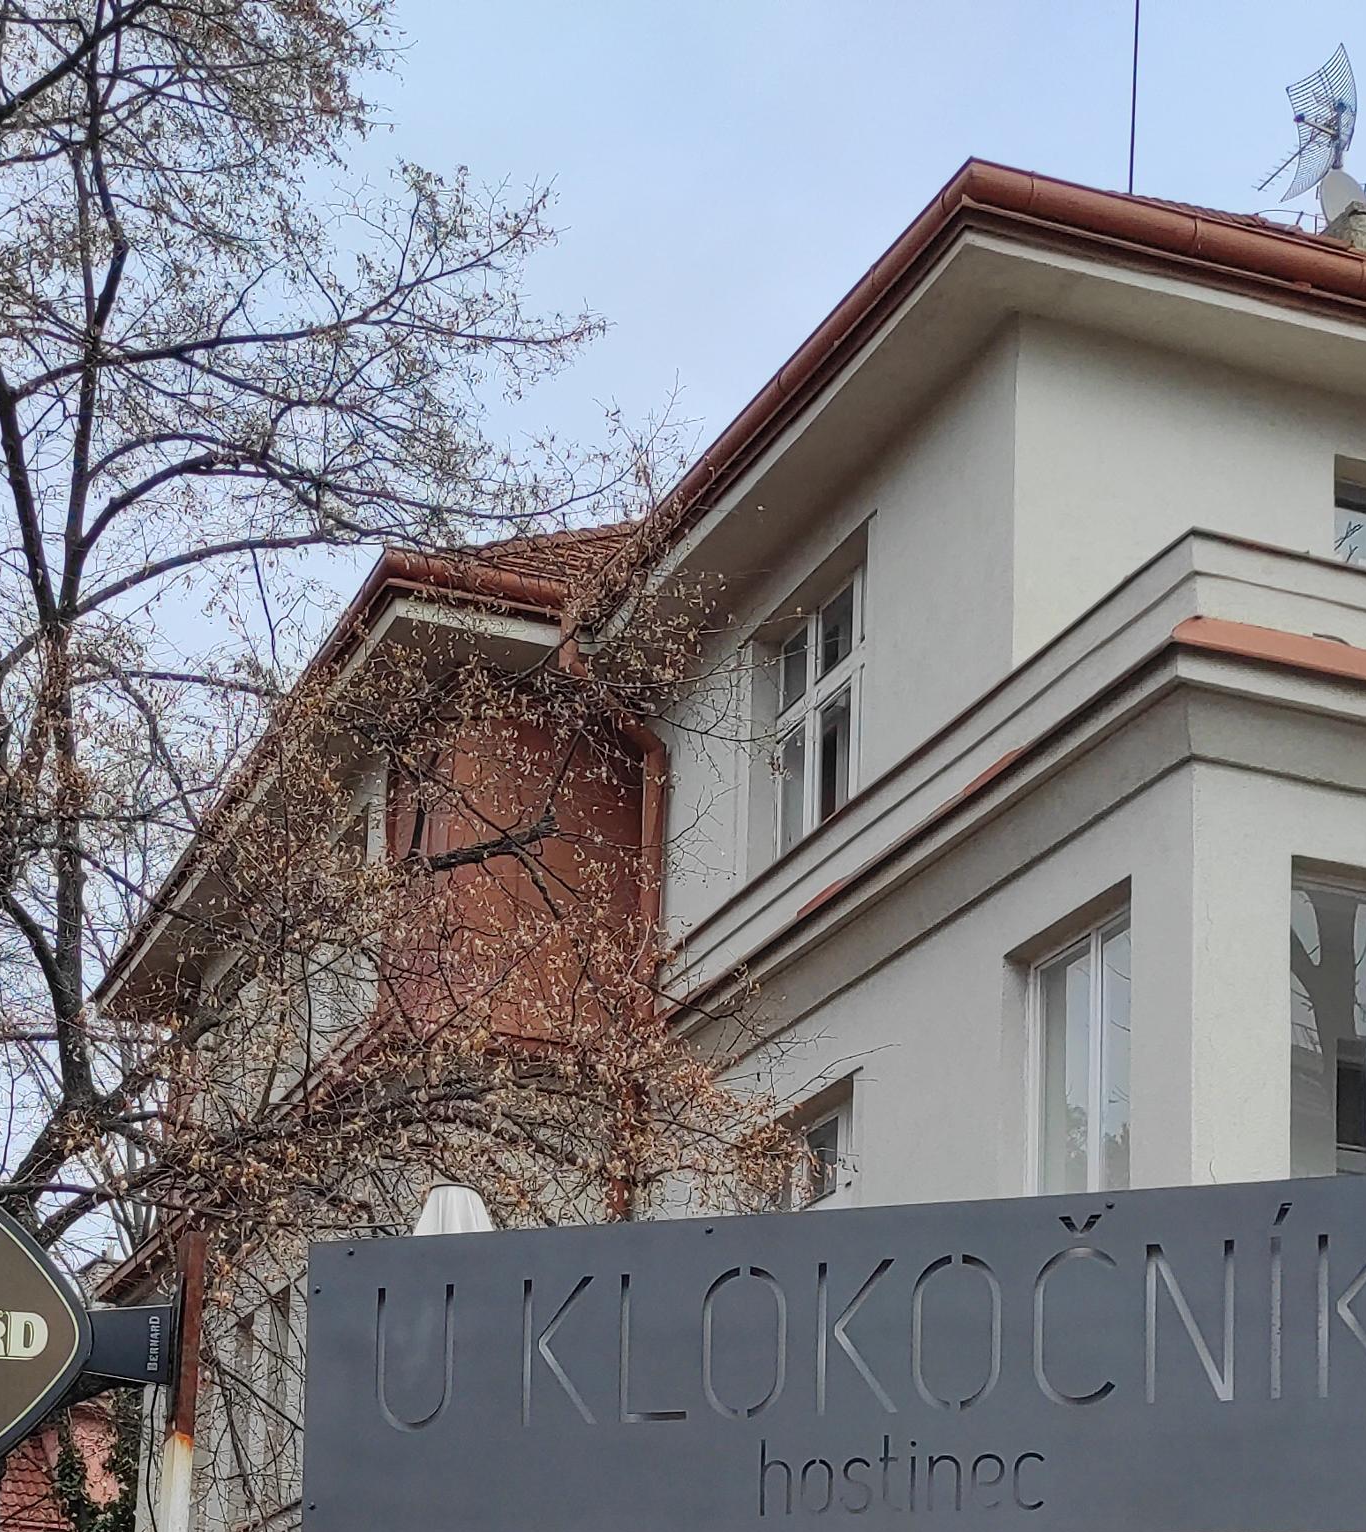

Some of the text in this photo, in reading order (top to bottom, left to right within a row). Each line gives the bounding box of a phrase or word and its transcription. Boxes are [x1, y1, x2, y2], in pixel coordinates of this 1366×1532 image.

[146, 1315, 161, 1373] BERNARD
[377, 1283, 455, 1431] U
[759, 1434, 1046, 1517] hostinec
